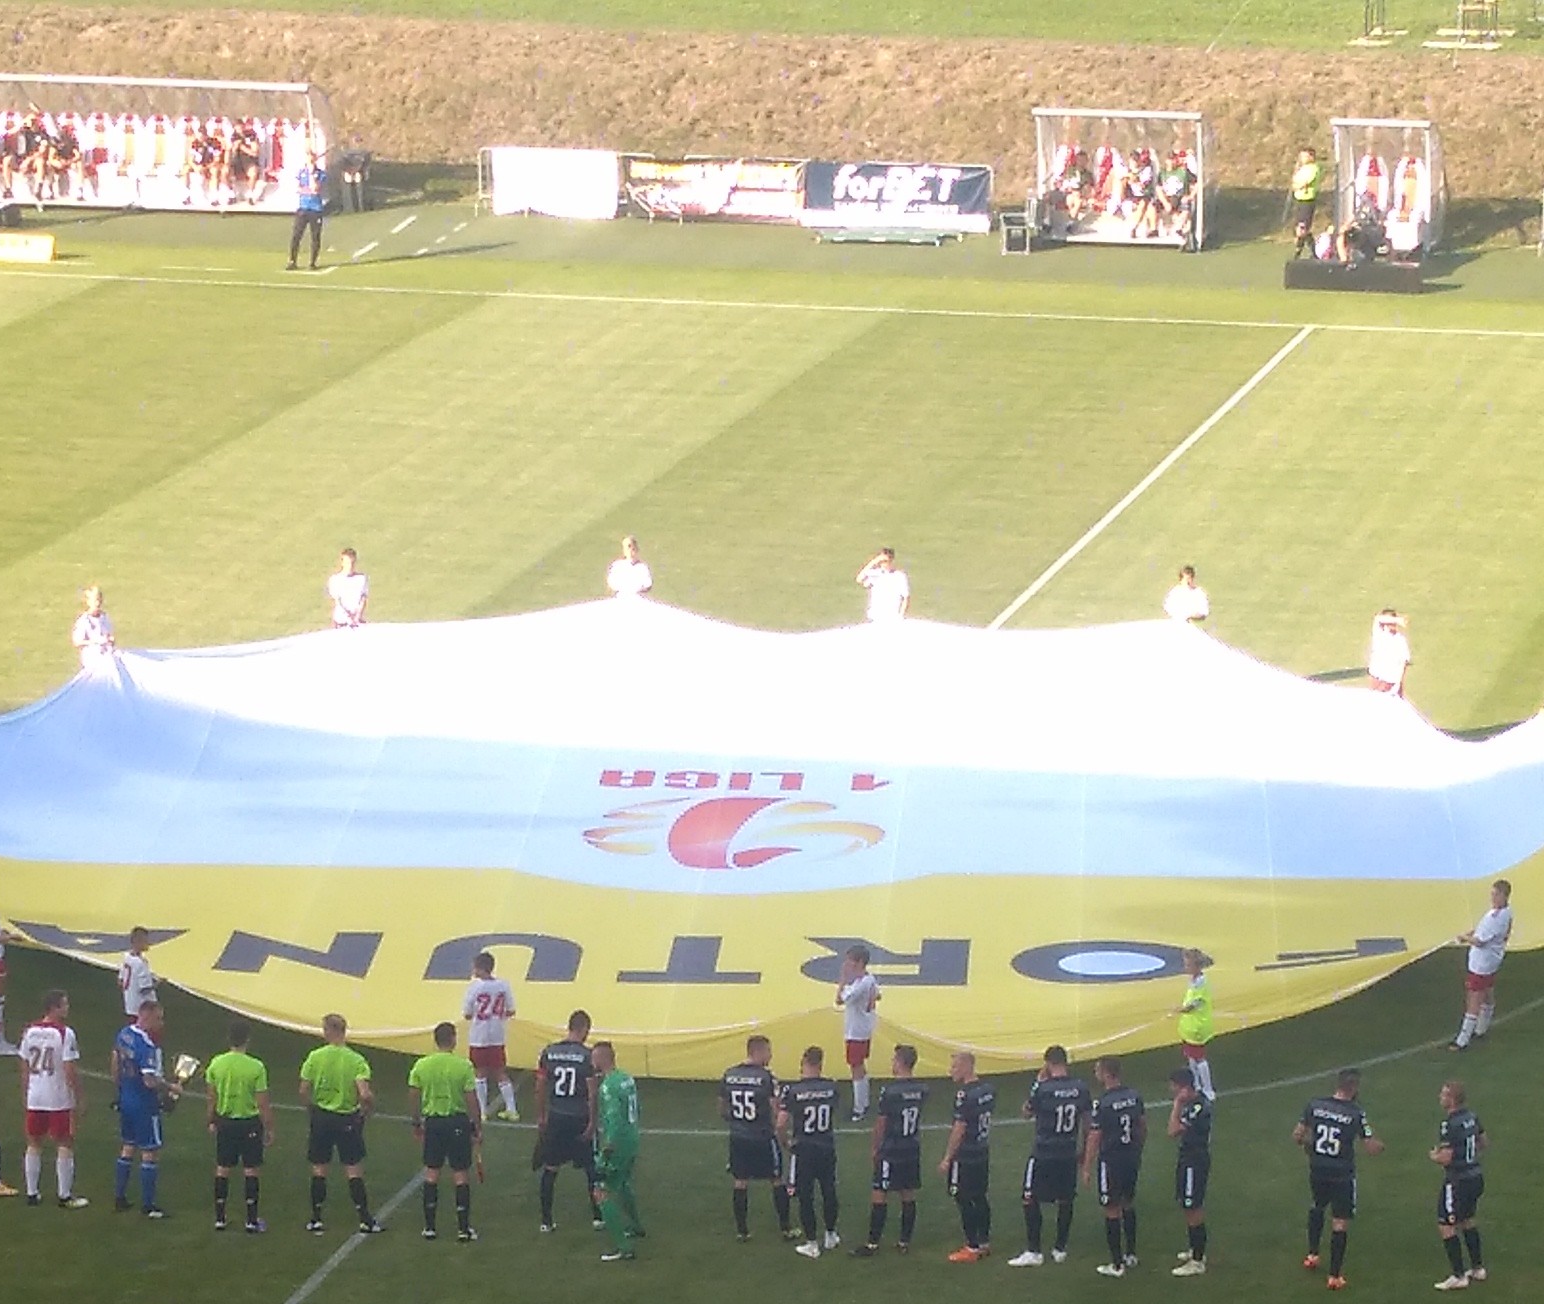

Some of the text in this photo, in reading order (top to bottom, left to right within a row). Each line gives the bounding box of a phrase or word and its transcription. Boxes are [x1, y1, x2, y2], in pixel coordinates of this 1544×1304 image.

[476, 992, 506, 1021] 24
[28, 1046, 56, 1077] 24
[553, 1066, 577, 1097] 27
[730, 1090, 757, 1121] 55
[803, 1103, 831, 1134] 20
[1055, 1104, 1077, 1133] 13
[1120, 1113, 1132, 1145] 3
[1315, 1124, 1342, 1156] 25
